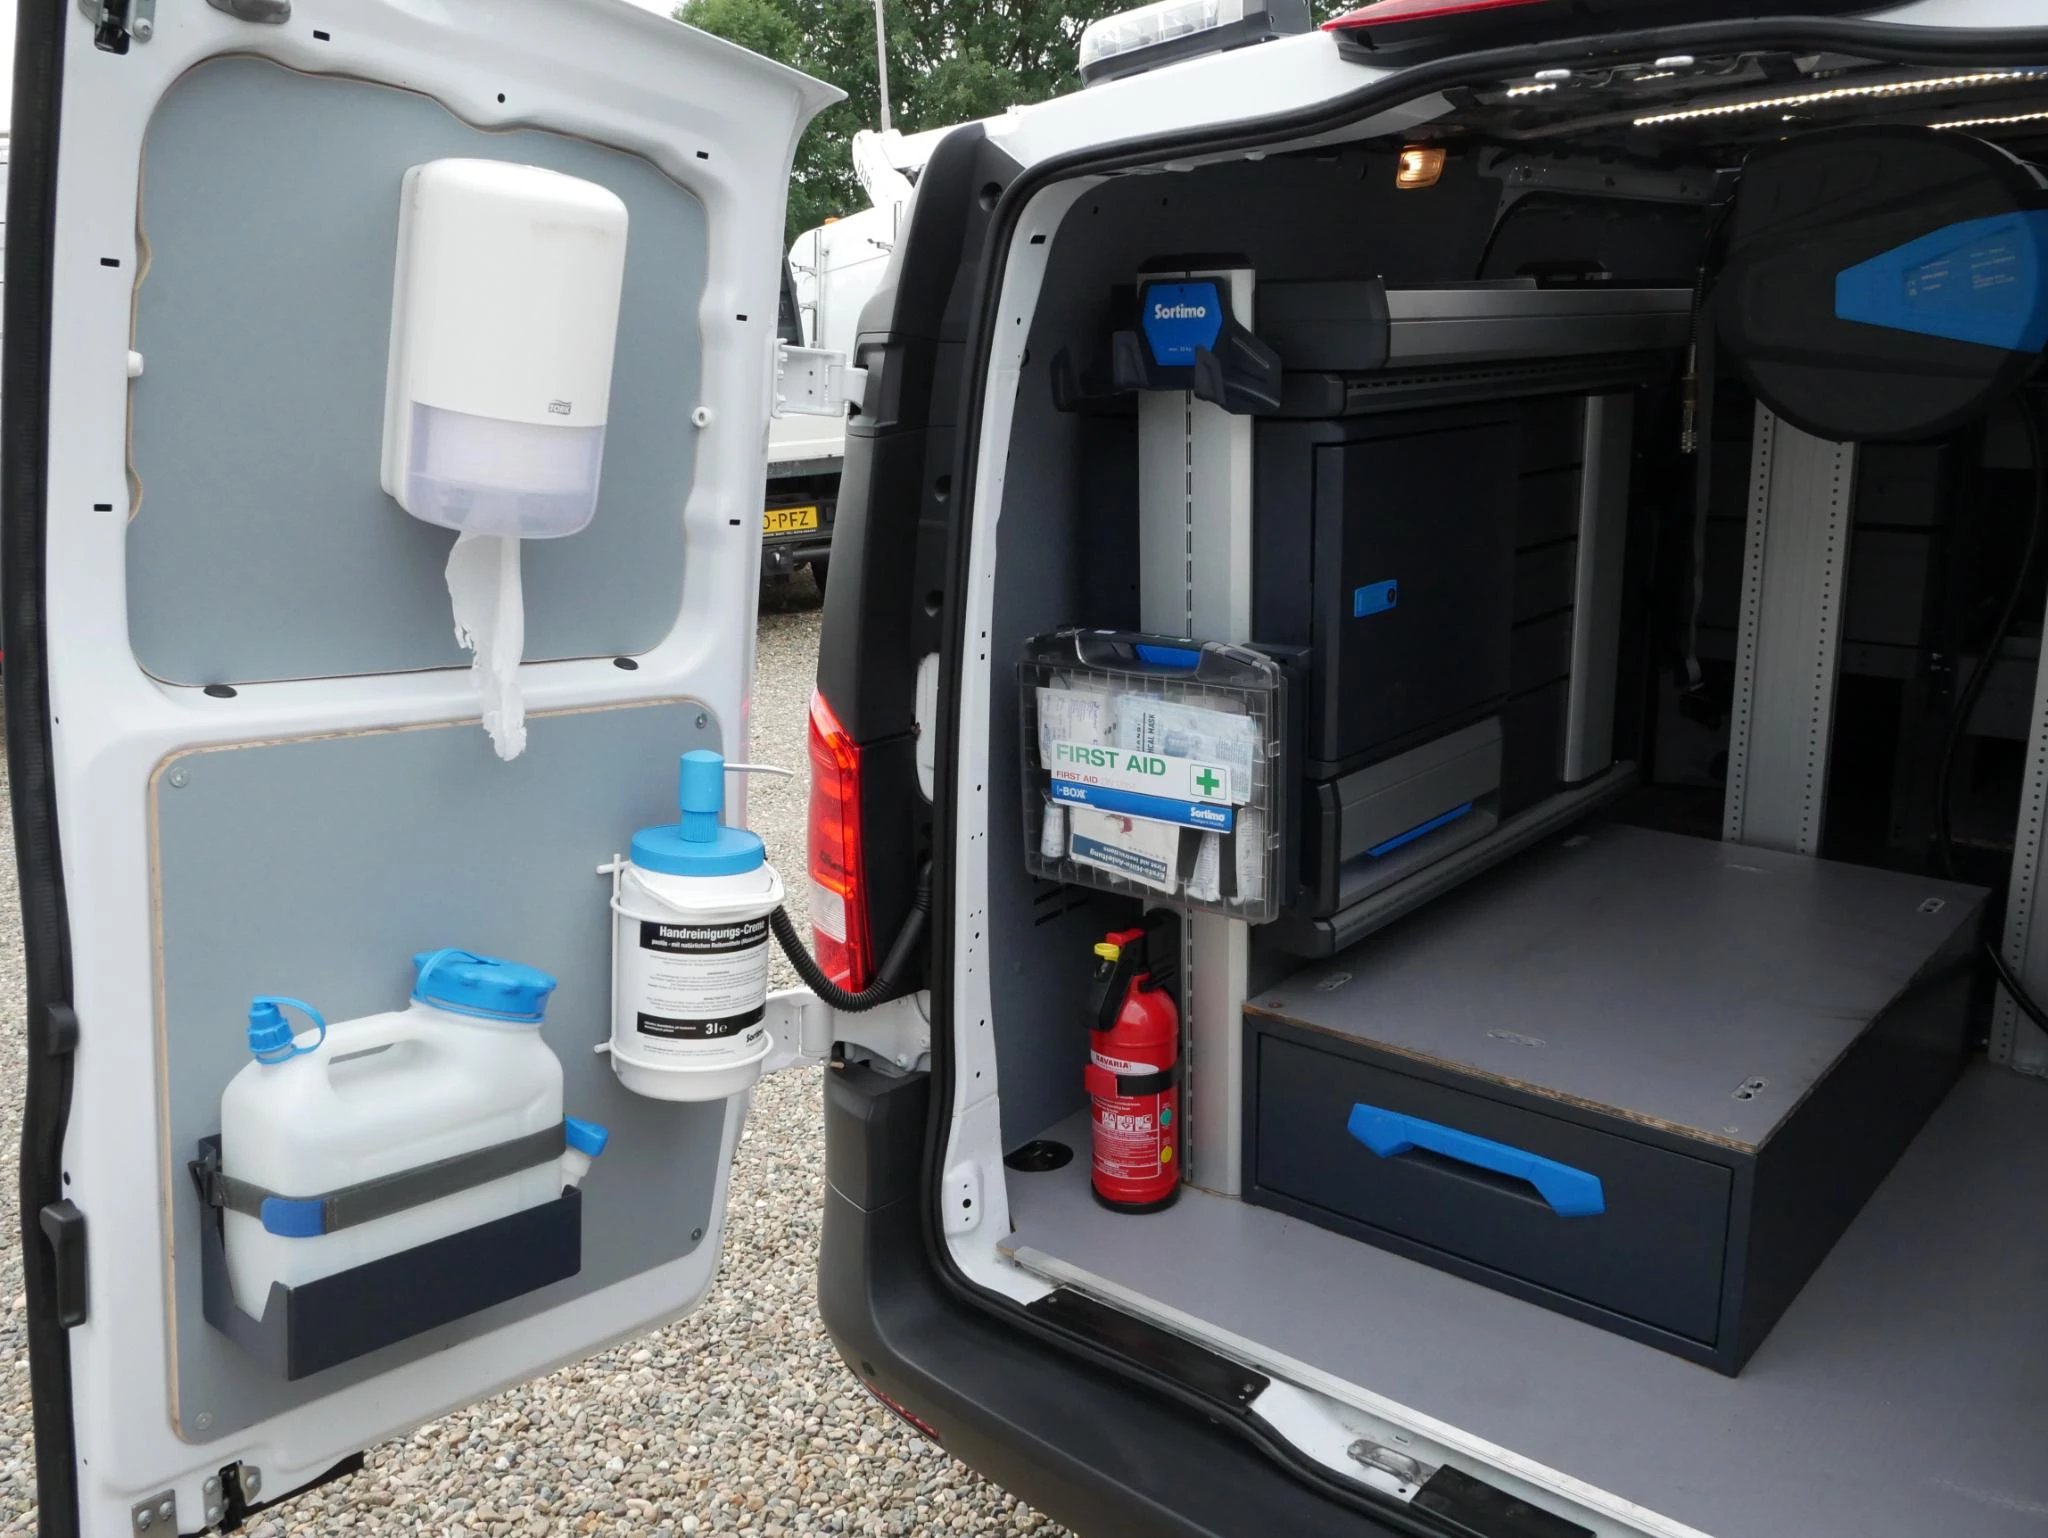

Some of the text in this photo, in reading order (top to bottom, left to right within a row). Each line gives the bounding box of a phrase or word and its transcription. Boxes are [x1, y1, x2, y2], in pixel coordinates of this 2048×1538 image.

[1155, 303, 1206, 320] Sortimo
[1147, 714, 1156, 735] MASK
[1056, 744, 1166, 776] FIRST AID
[1056, 770, 1080, 781] FIRST
[1083, 775, 1098, 784] AID
[1190, 806, 1226, 822] Sortimo
[1095, 1054, 1129, 1069] BAVARIA
